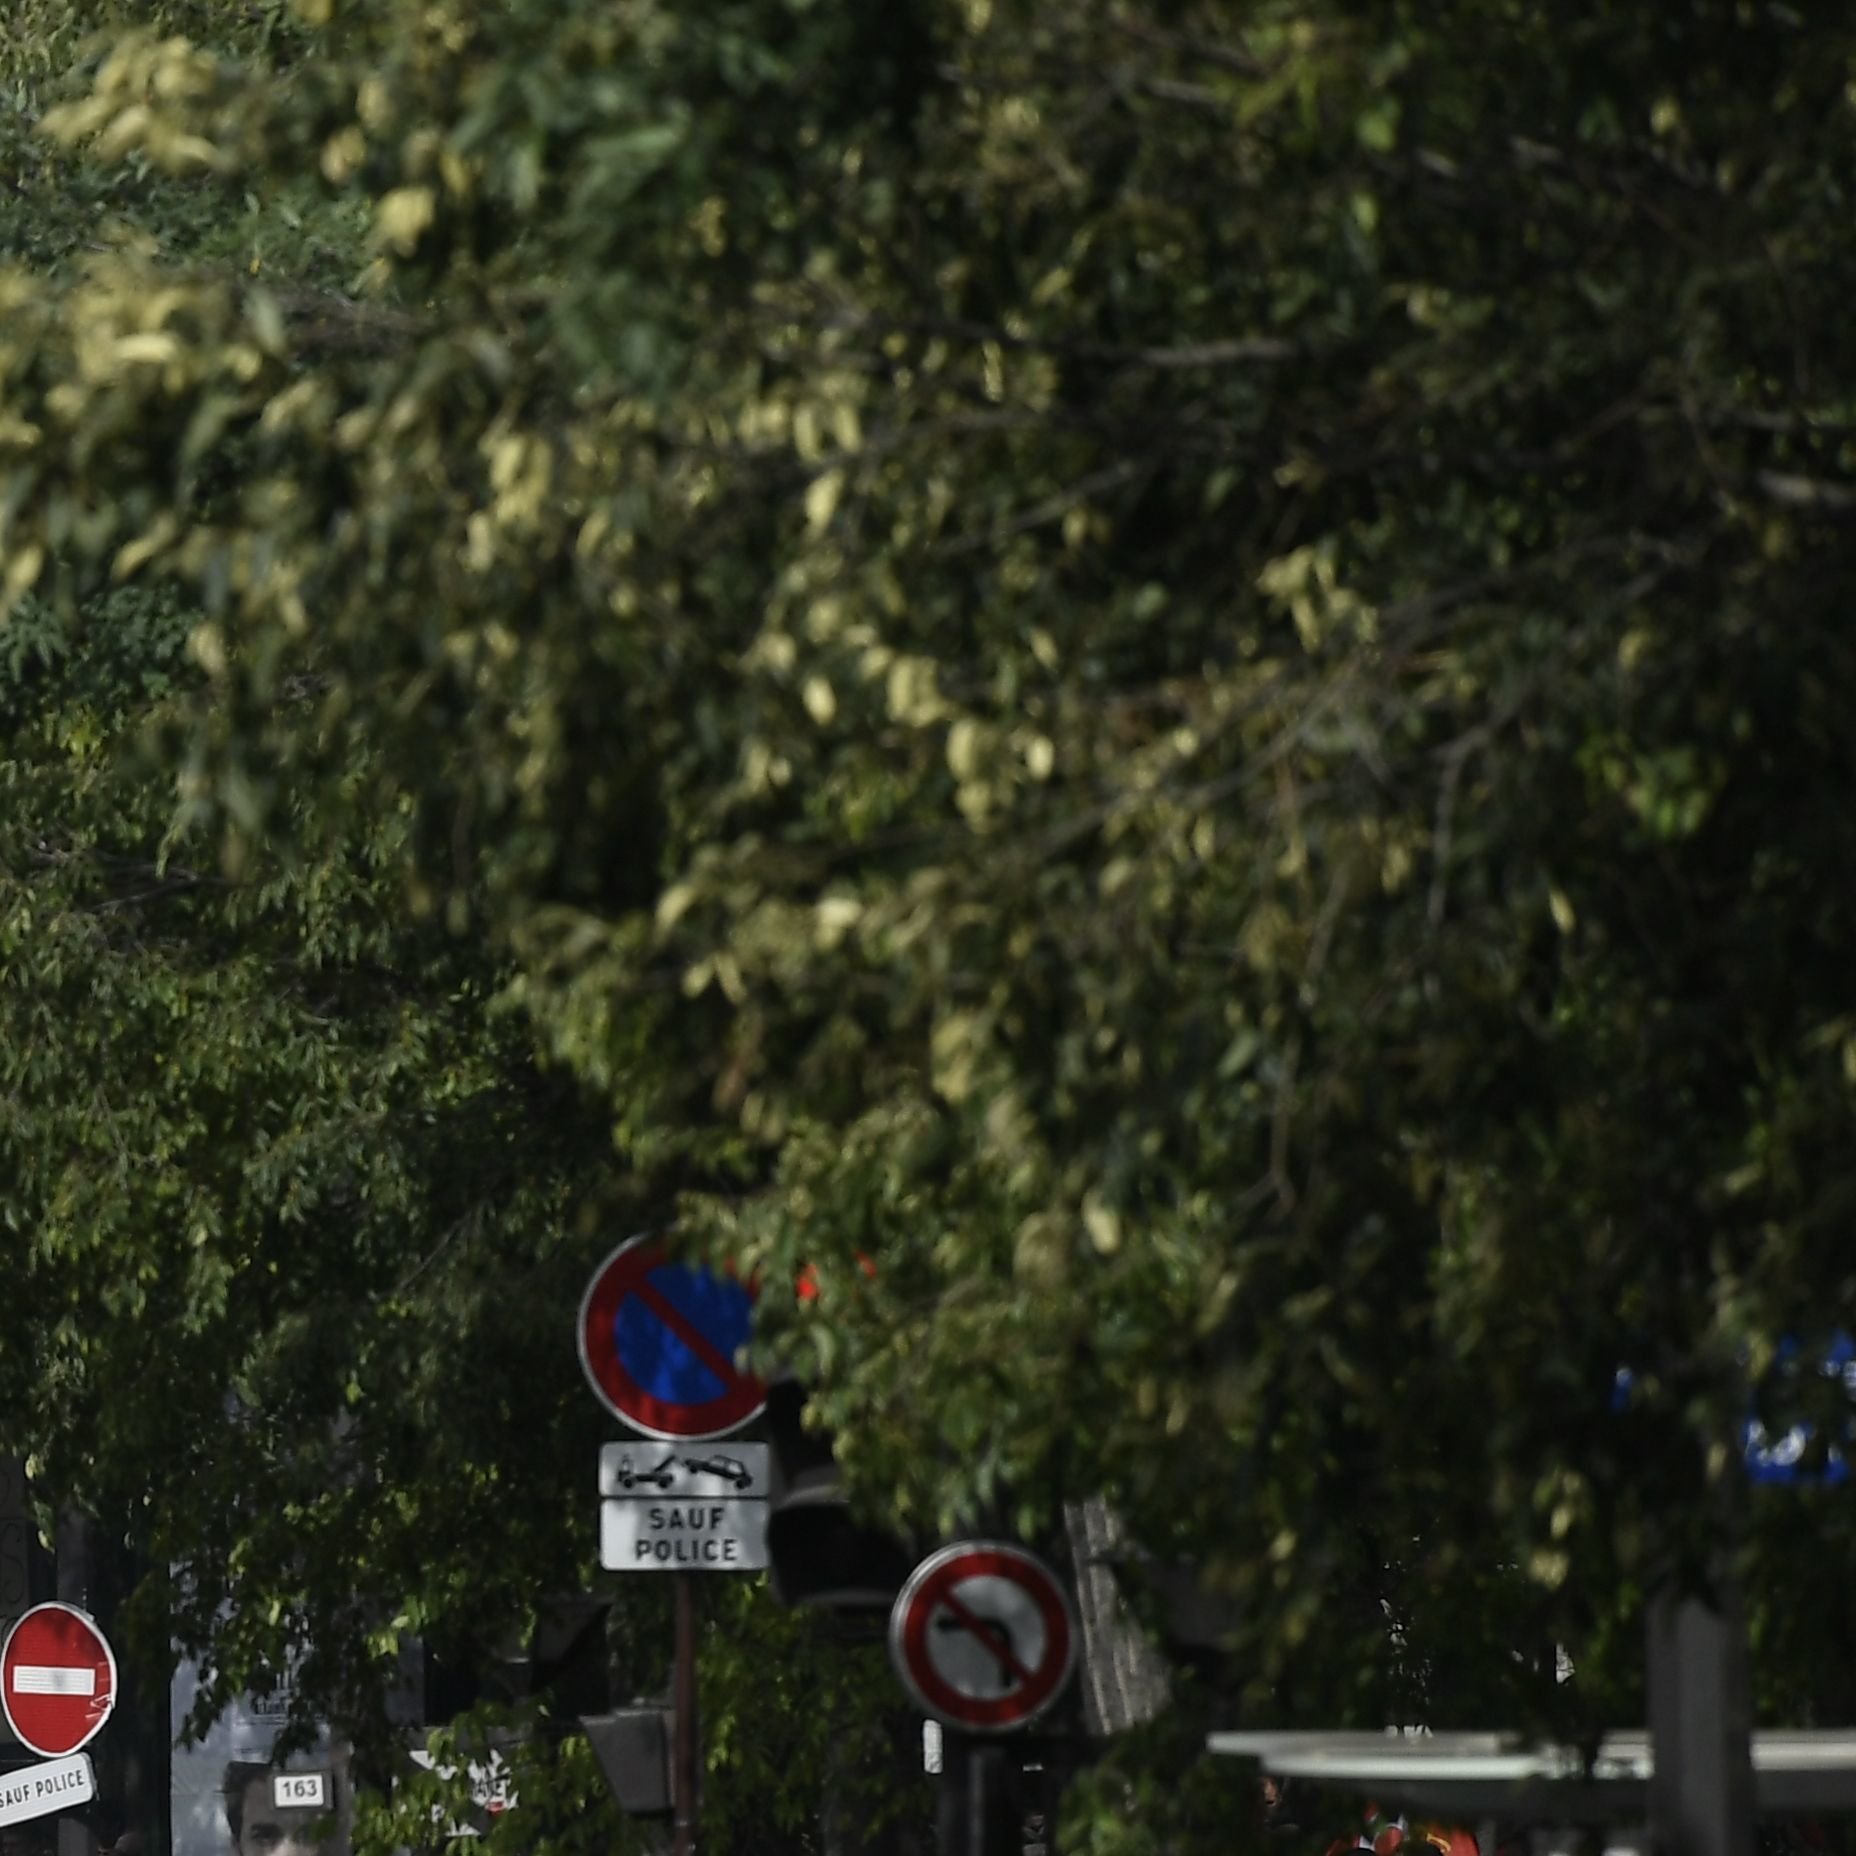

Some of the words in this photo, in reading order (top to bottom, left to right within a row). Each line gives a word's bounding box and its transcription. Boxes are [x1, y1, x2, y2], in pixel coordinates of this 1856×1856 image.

[649, 1508, 725, 1530] SAUF
[635, 1540, 738, 1561] POLICE
[35, 1769, 85, 1798] POLICE
[283, 1780, 318, 1797] 163
